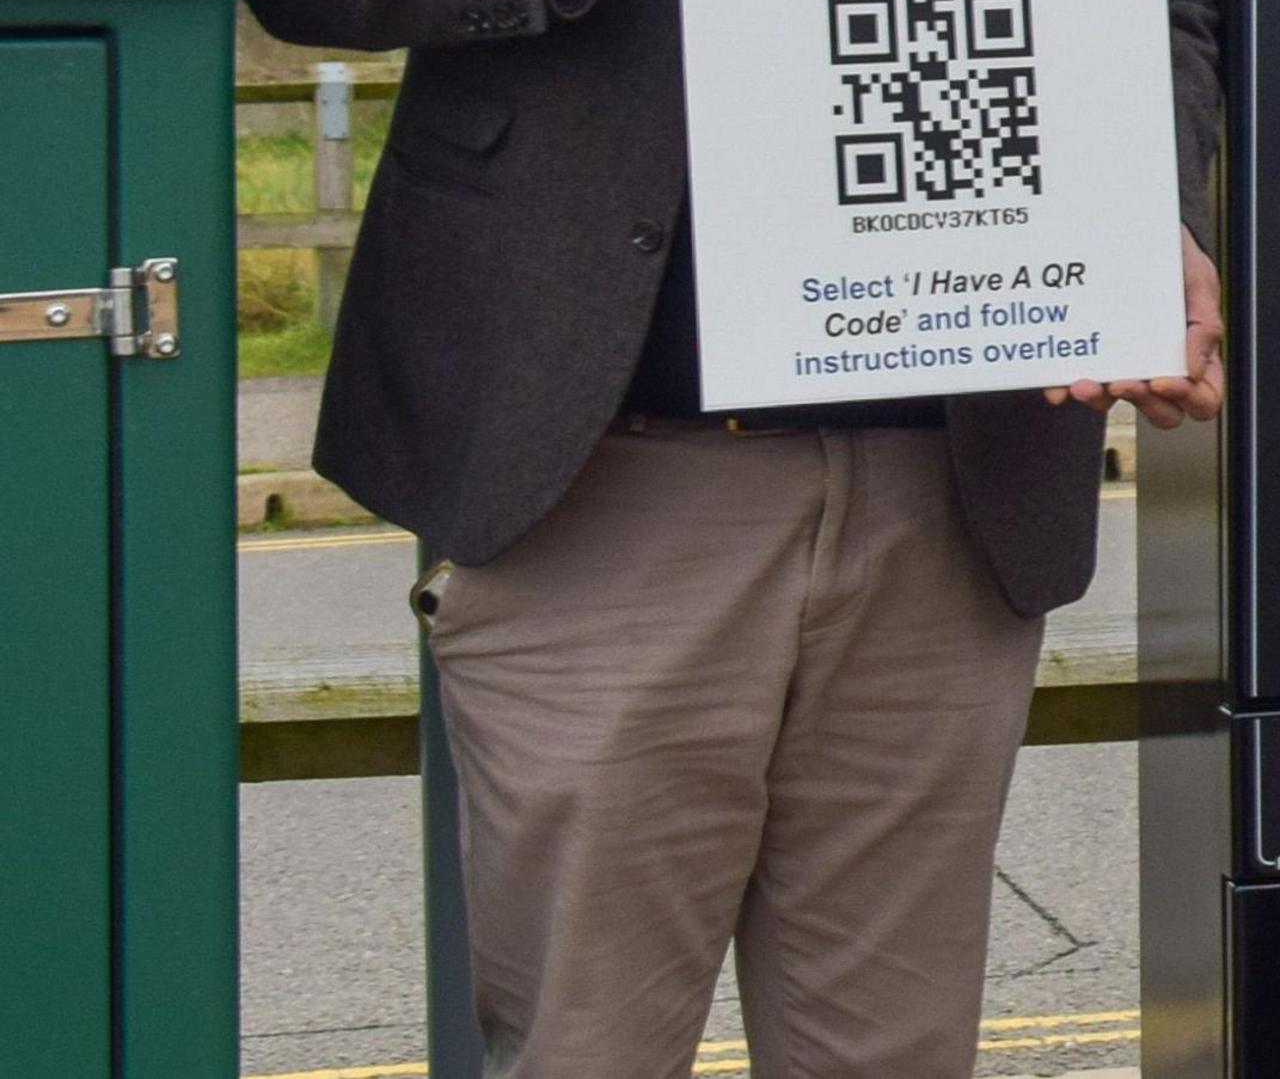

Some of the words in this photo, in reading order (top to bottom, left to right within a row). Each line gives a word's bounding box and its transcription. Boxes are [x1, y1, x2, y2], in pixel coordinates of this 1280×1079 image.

[802, 275, 894, 303] Select
[931, 270, 1003, 297] Have
[1011, 266, 1033, 290] A
[1041, 261, 1086, 290] QR
[825, 309, 909, 337] Code’
[917, 306, 971, 332] and
[980, 302, 1069, 327] follow
[795, 343, 974, 375] instructions
[983, 332, 1100, 363] overleaf
